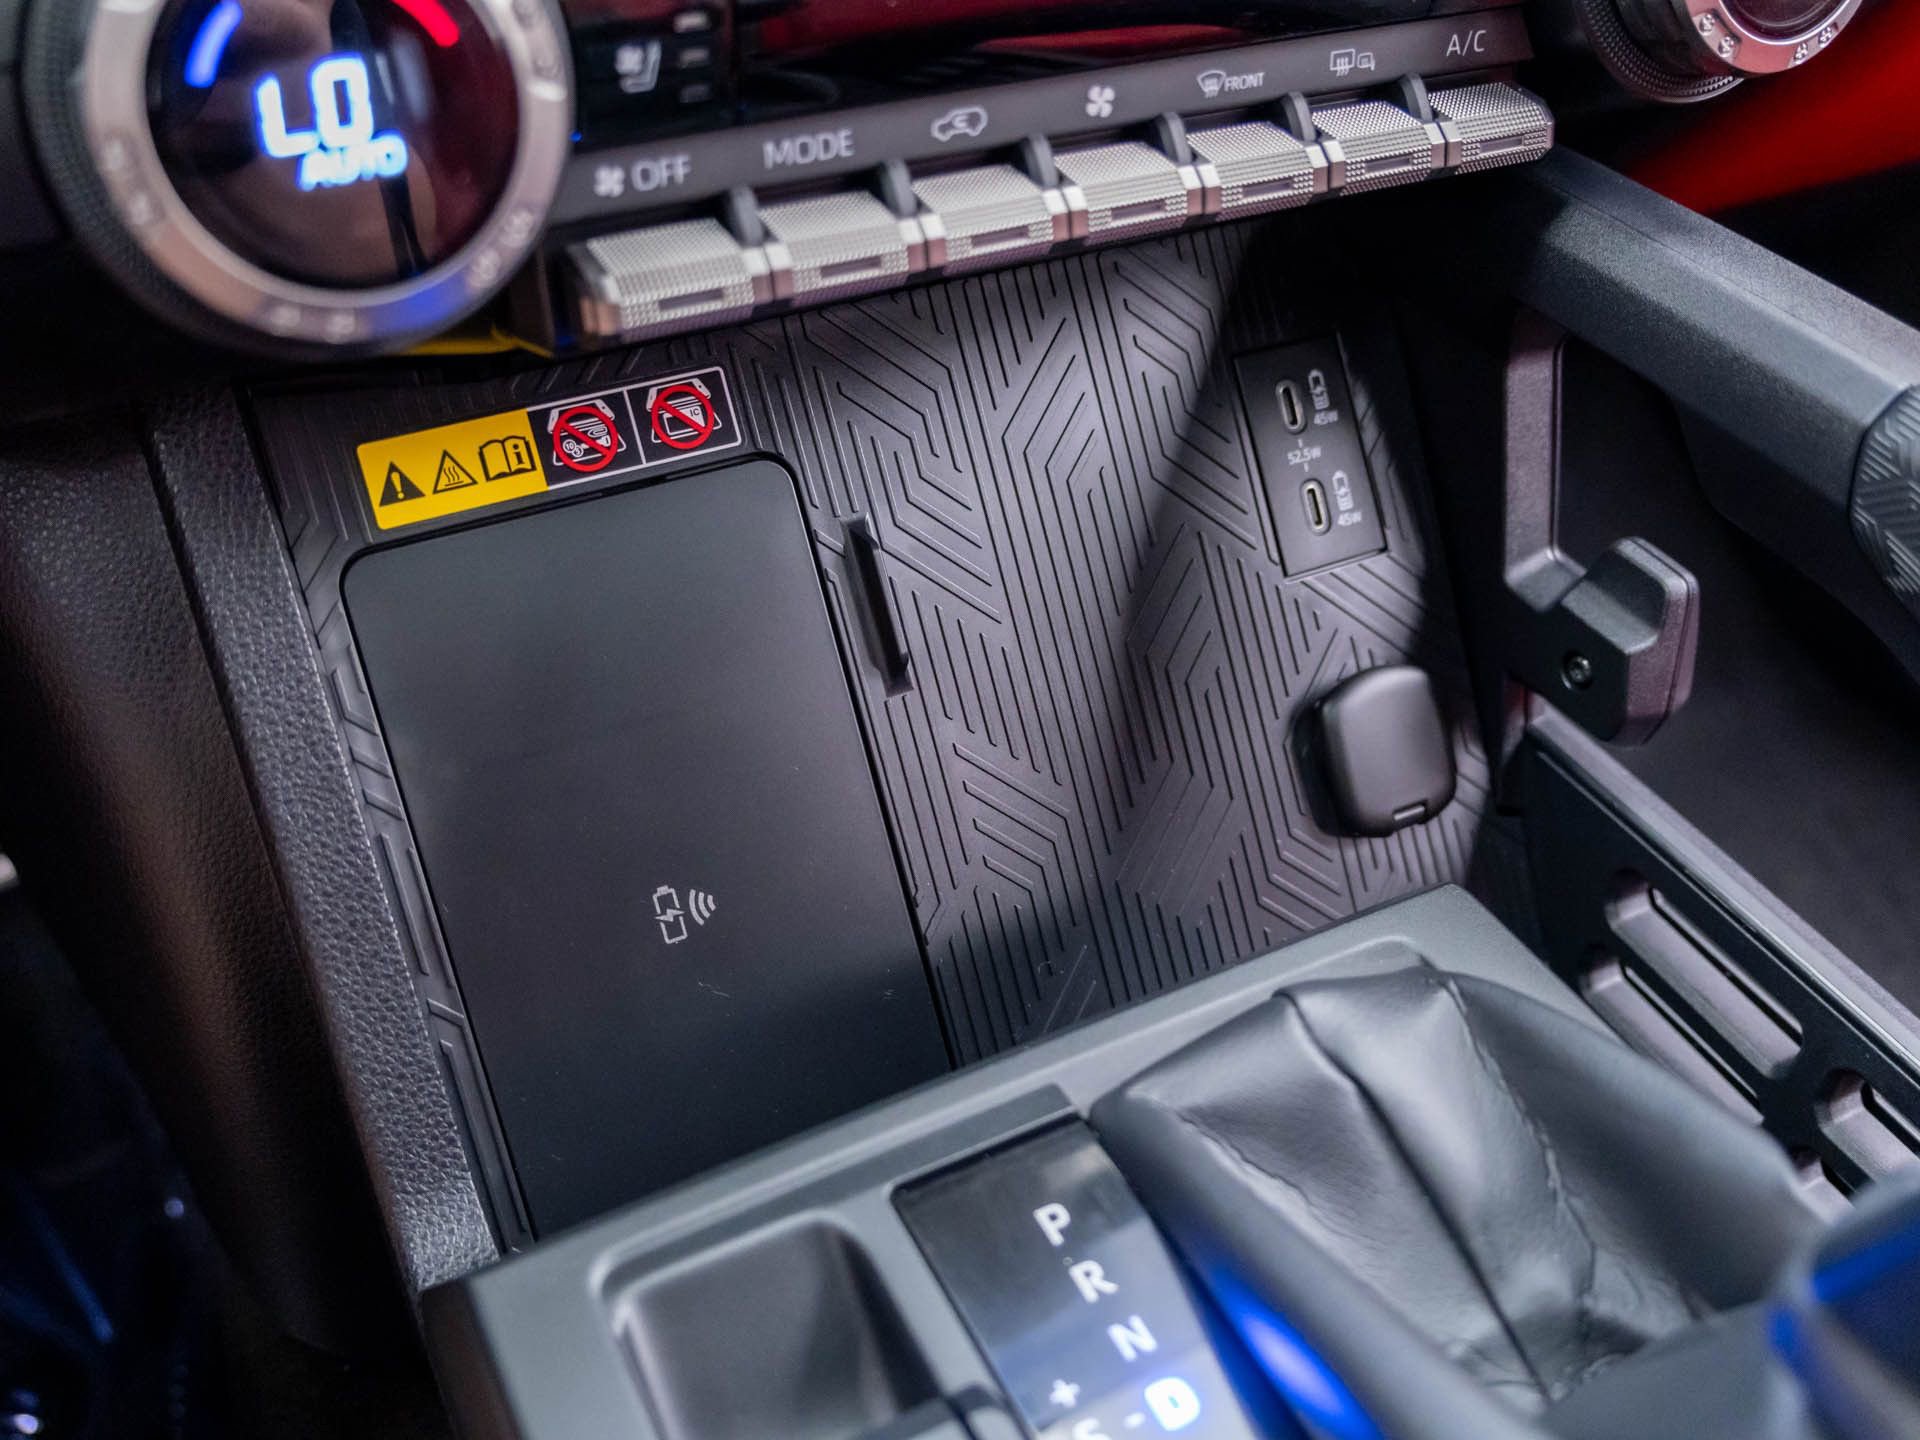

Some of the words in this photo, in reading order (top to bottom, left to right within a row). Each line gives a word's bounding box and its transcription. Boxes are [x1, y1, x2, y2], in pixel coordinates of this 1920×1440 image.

[1446, 30, 1488, 56] A/C
[1223, 72, 1266, 92] FRONT
[299, 133, 409, 191] AUTO
[762, 129, 856, 169] MODE
[631, 154, 691, 192] OFF
[1033, 1202, 1071, 1246] P
[1068, 1260, 1119, 1303] R
[1107, 1315, 1158, 1362] N
